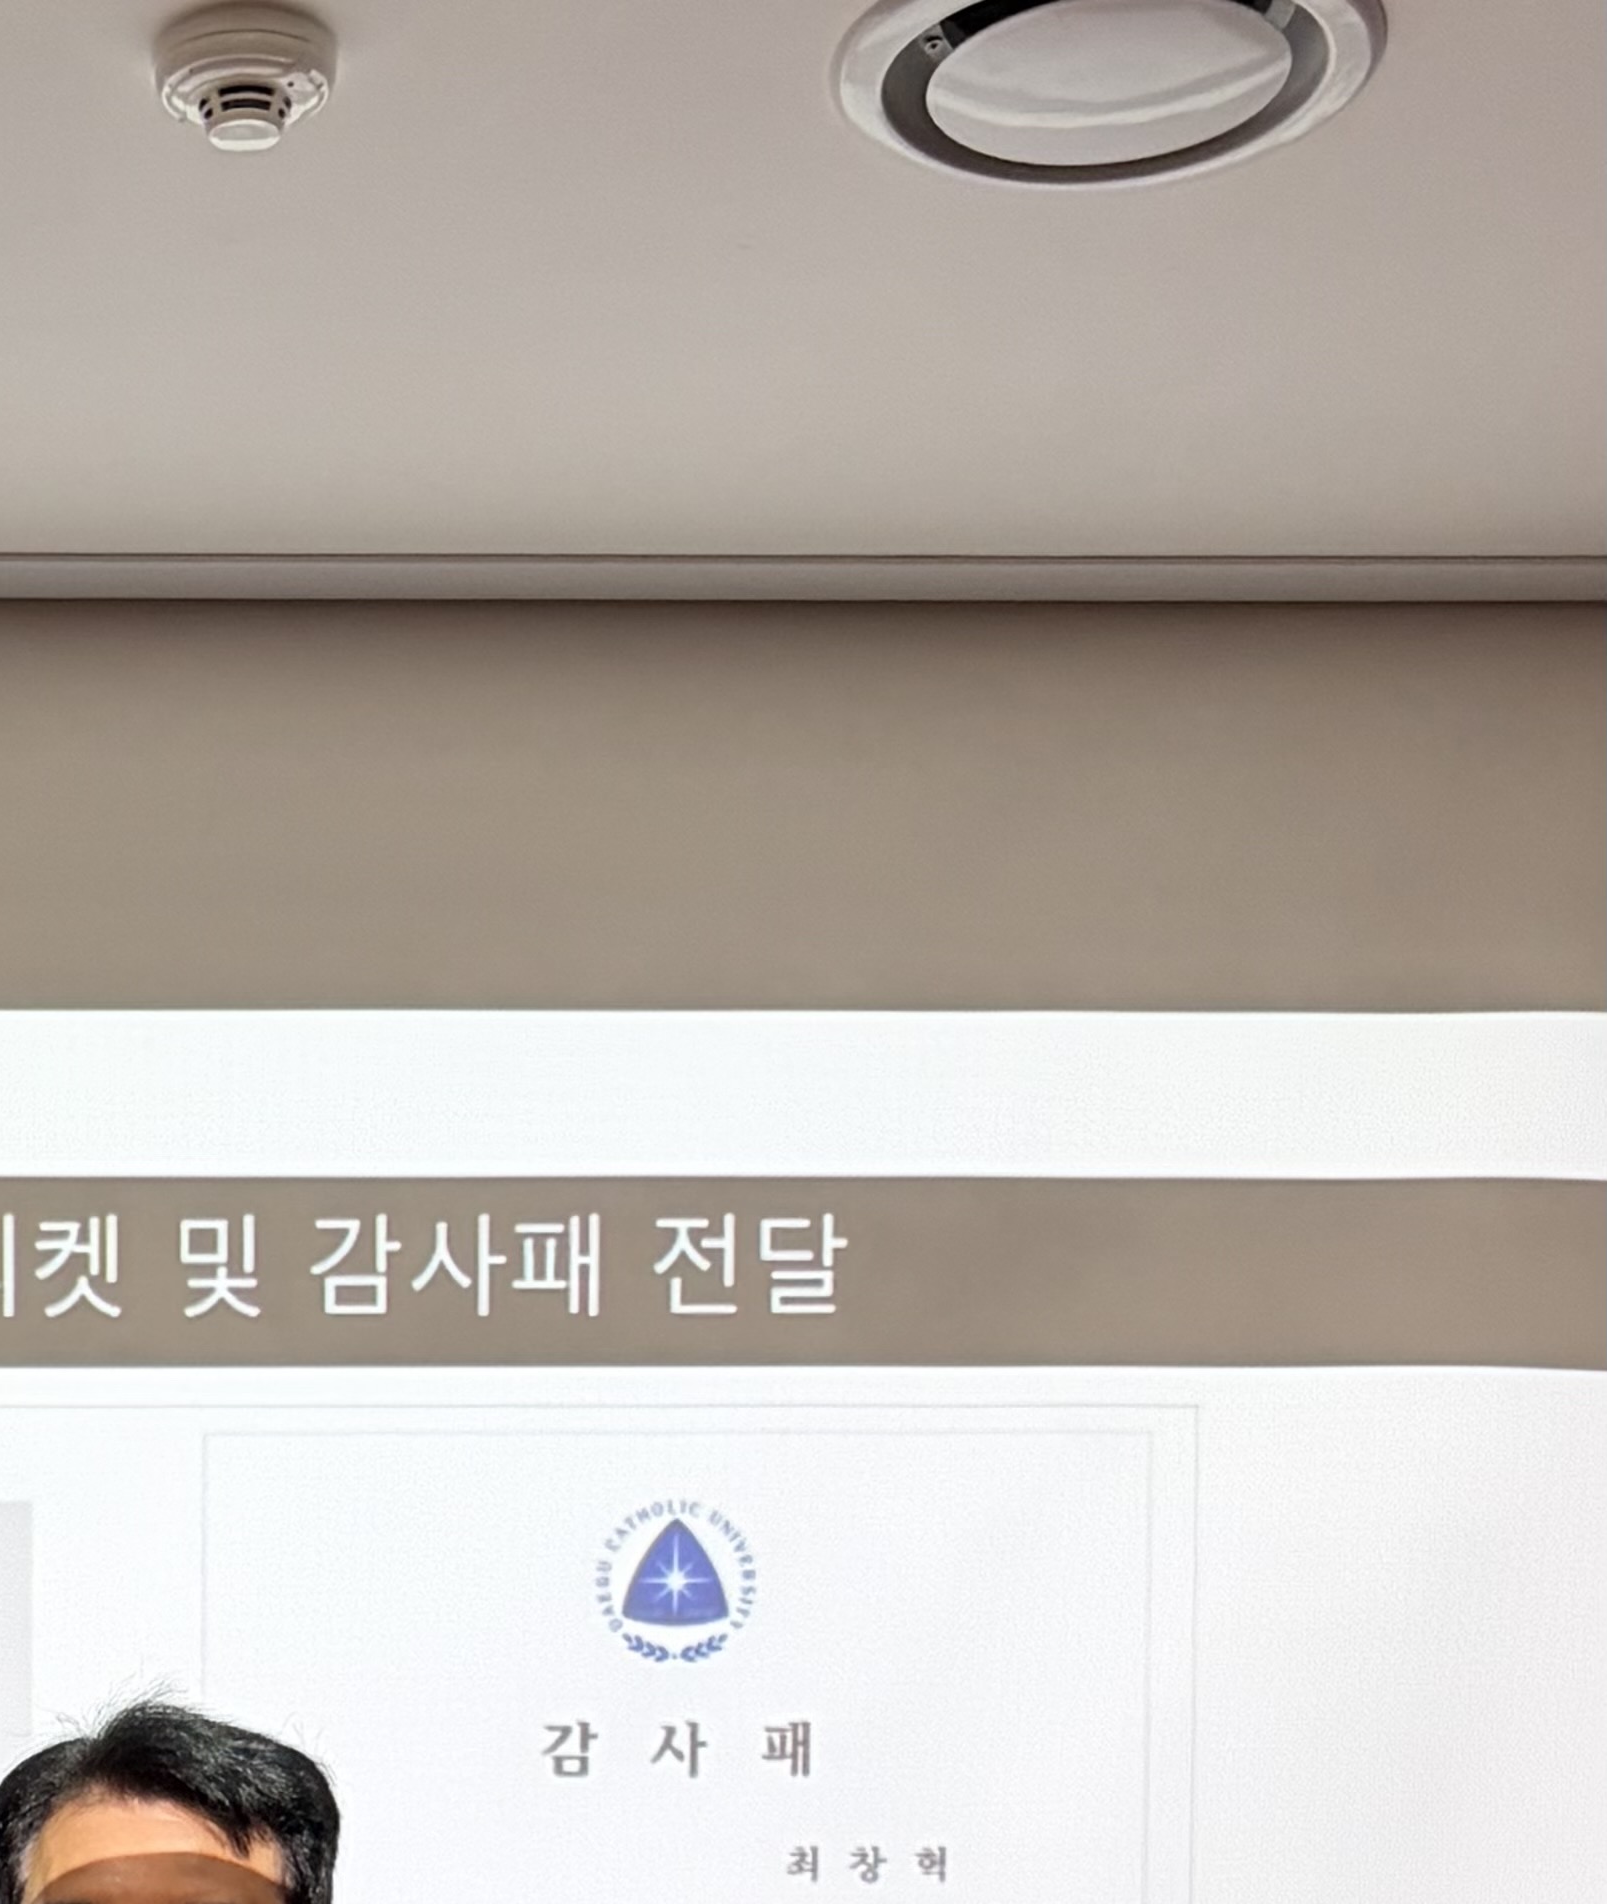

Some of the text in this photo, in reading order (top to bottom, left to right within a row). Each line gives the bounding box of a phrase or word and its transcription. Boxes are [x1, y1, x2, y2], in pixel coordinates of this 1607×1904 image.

[179, 1213, 262, 1318] 및
[309, 1212, 601, 1318] 감사패
[653, 1212, 849, 1316] 전달
[604, 1499, 700, 1553] CATHOLIC
